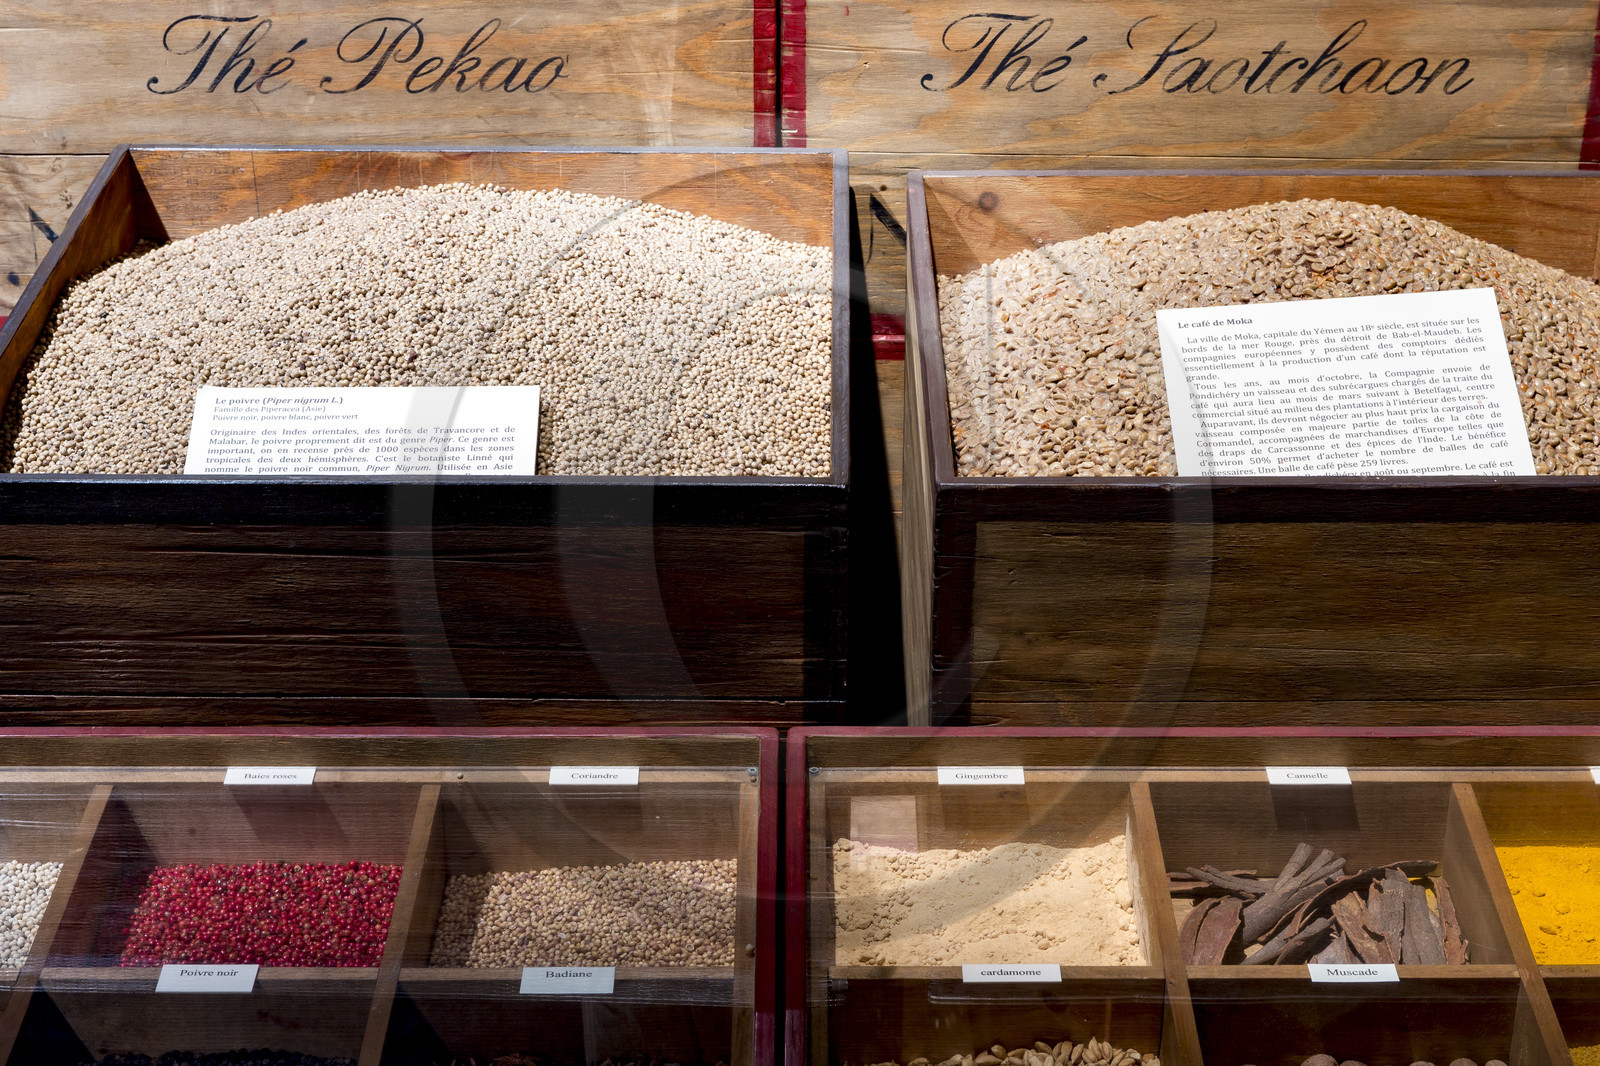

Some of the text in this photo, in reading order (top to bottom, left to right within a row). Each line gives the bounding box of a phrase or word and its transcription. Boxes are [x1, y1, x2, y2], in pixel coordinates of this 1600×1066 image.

[146, 14, 570, 96] Thé Pekao
[920, 13, 1088, 93] Thé
[1177, 316, 1253, 329] Le café de Moka
[1180, 344, 1208, 354] bords
[1211, 343, 1224, 352] de
[1227, 342, 1236, 350] la
[1263, 338, 1295, 350] Rouge,
[1298, 337, 1320, 347] près
[1322, 336, 1336, 344] du
[1339, 333, 1372, 343] détroit
[1375, 332, 1388, 340] de
[1391, 327, 1462, 339] Bab-el-Maudeb.
[1465, 326, 1482, 334] Les
[1182, 352, 1237, 365] compagnies
[1243, 347, 1303, 360] européennes
[1322, 343, 1370, 355] possèdent
[1376, 341, 1394, 350] des
[1400, 338, 1447, 350] comptoirs
[1453, 335, 1484, 344] dédiés
[1183, 360, 1255, 372] essentiellement
[1268, 358, 1278, 366] la
[1280, 355, 1332, 367] production
[1334, 353, 1356, 362] d'un
[1359, 351, 1379, 360] café
[1381, 350, 1404, 359] dont
[1407, 349, 1417, 357] la
[1420, 345, 1469, 358] réputation
[1184, 372, 1220, 383] grande.
[1188, 389, 1241, 402] Pondichéry
[1256, 386, 1296, 396] vaisseau
[1308, 384, 1326, 392] des
[1327, 379, 1389, 393] subrécargues
[1390, 377, 1427, 388] chargés
[1427, 376, 1440, 384] de
[1441, 375, 1451, 383] la
[1452, 374, 1479, 382] traite
[1479, 372, 1493, 381] du
[228, 396, 261, 405] poivre
[261, 395, 293, 405] (Piper
[292, 395, 329, 404] nigrum
[330, 395, 344, 404] L.)
[1190, 408, 1245, 419] commercial
[1245, 406, 1269, 416] situé
[1283, 404, 1313, 413] milieu
[1313, 402, 1331, 411] des
[1331, 399, 1384, 412] plantations
[1384, 398, 1392, 406] à
[1392, 395, 1439, 406] l'intérieur
[1439, 394, 1457, 403] des
[1457, 392, 1488, 401] terres.
[260, 403, 300, 413] Piperacea
[260, 412, 287, 421] poivre
[313, 412, 340, 420] poivre
[209, 428, 257, 437] Originaire
[311, 427, 360, 435] orientales,
[432, 425, 485, 433] Travancore
[1195, 421, 1505, 449] Coromandel, accompagnées de marchandises d'Europe telles que
[208, 437, 248, 446] Malabar,
[261, 437, 292, 446] poivre
[294, 437, 350, 446] proprement
[428, 435, 455, 445] Piper.
[206, 447, 256, 456] important,
[332, 445, 354, 455] près
[402, 445, 439, 454] espèces
[205, 455, 251, 465] tropicales
[307, 454, 369, 464] hémisphères.
[497, 454, 513, 463] qui
[257, 465, 288, 474] poivre
[364, 464, 390, 473] Piper
[394, 463, 431, 473] Nigrum.
[1200, 456, 1408, 477] nécessaires. Une balle de café pèse 259 livres.
[955, 772, 1009, 781] Gingembre
[545, 970, 593, 978] Badiane
[1326, 968, 1379, 976] Muscade
